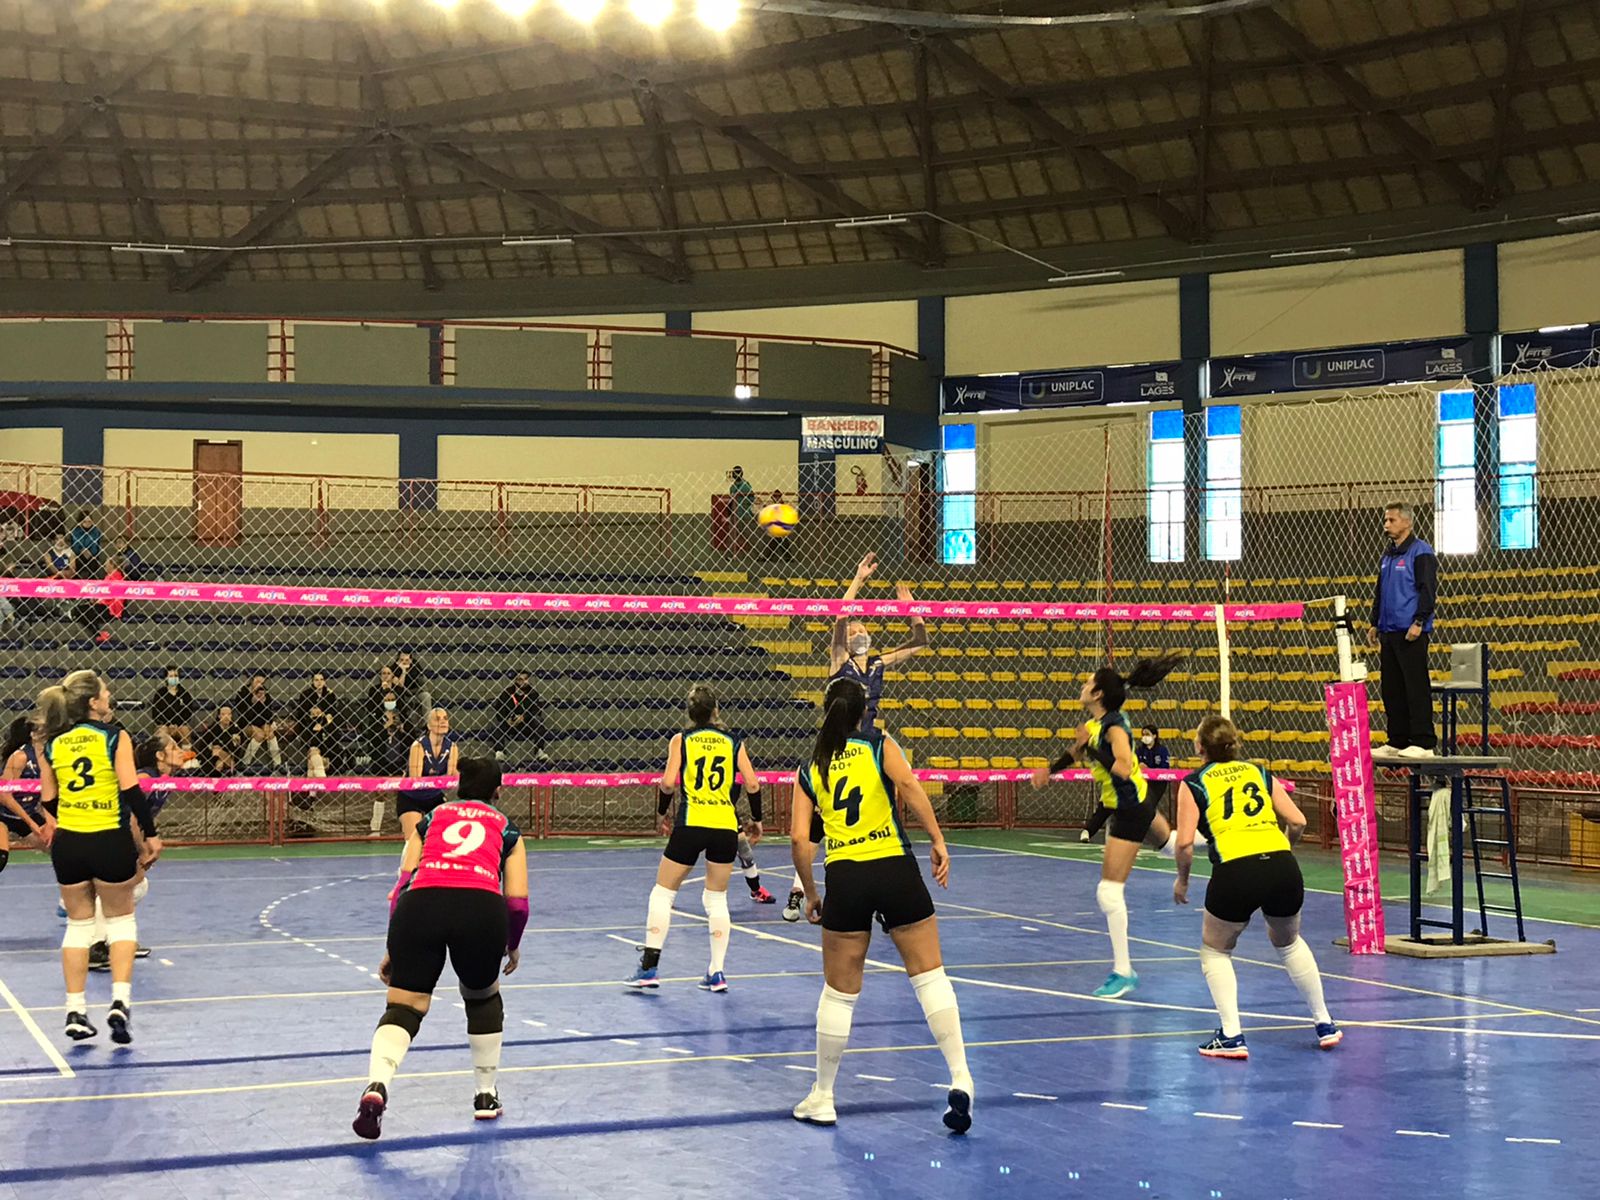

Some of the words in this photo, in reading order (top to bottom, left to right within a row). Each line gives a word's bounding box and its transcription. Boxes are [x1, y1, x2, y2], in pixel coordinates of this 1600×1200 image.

[1327, 358, 1375, 372] UNIPLAC
[1425, 362, 1463, 375] LAGES
[1051, 379, 1095, 392] UNIPLAC
[1140, 386, 1175, 397] LAGES
[807, 420, 878, 432] BANHEIRO
[807, 436, 878, 449] MASCULINO
[690, 736, 726, 744] VOLEIBOL
[67, 756, 95, 792] 3
[694, 755, 726, 791] 15
[829, 762, 852, 772] 40+
[1205, 764, 1250, 779] VOLEIBOL
[833, 775, 864, 827] 4
[1220, 781, 1265, 820] 13
[442, 820, 486, 859] 9
[827, 838, 846, 852] Rio
[848, 836, 866, 846] do
[868, 825, 892, 841] Sul
